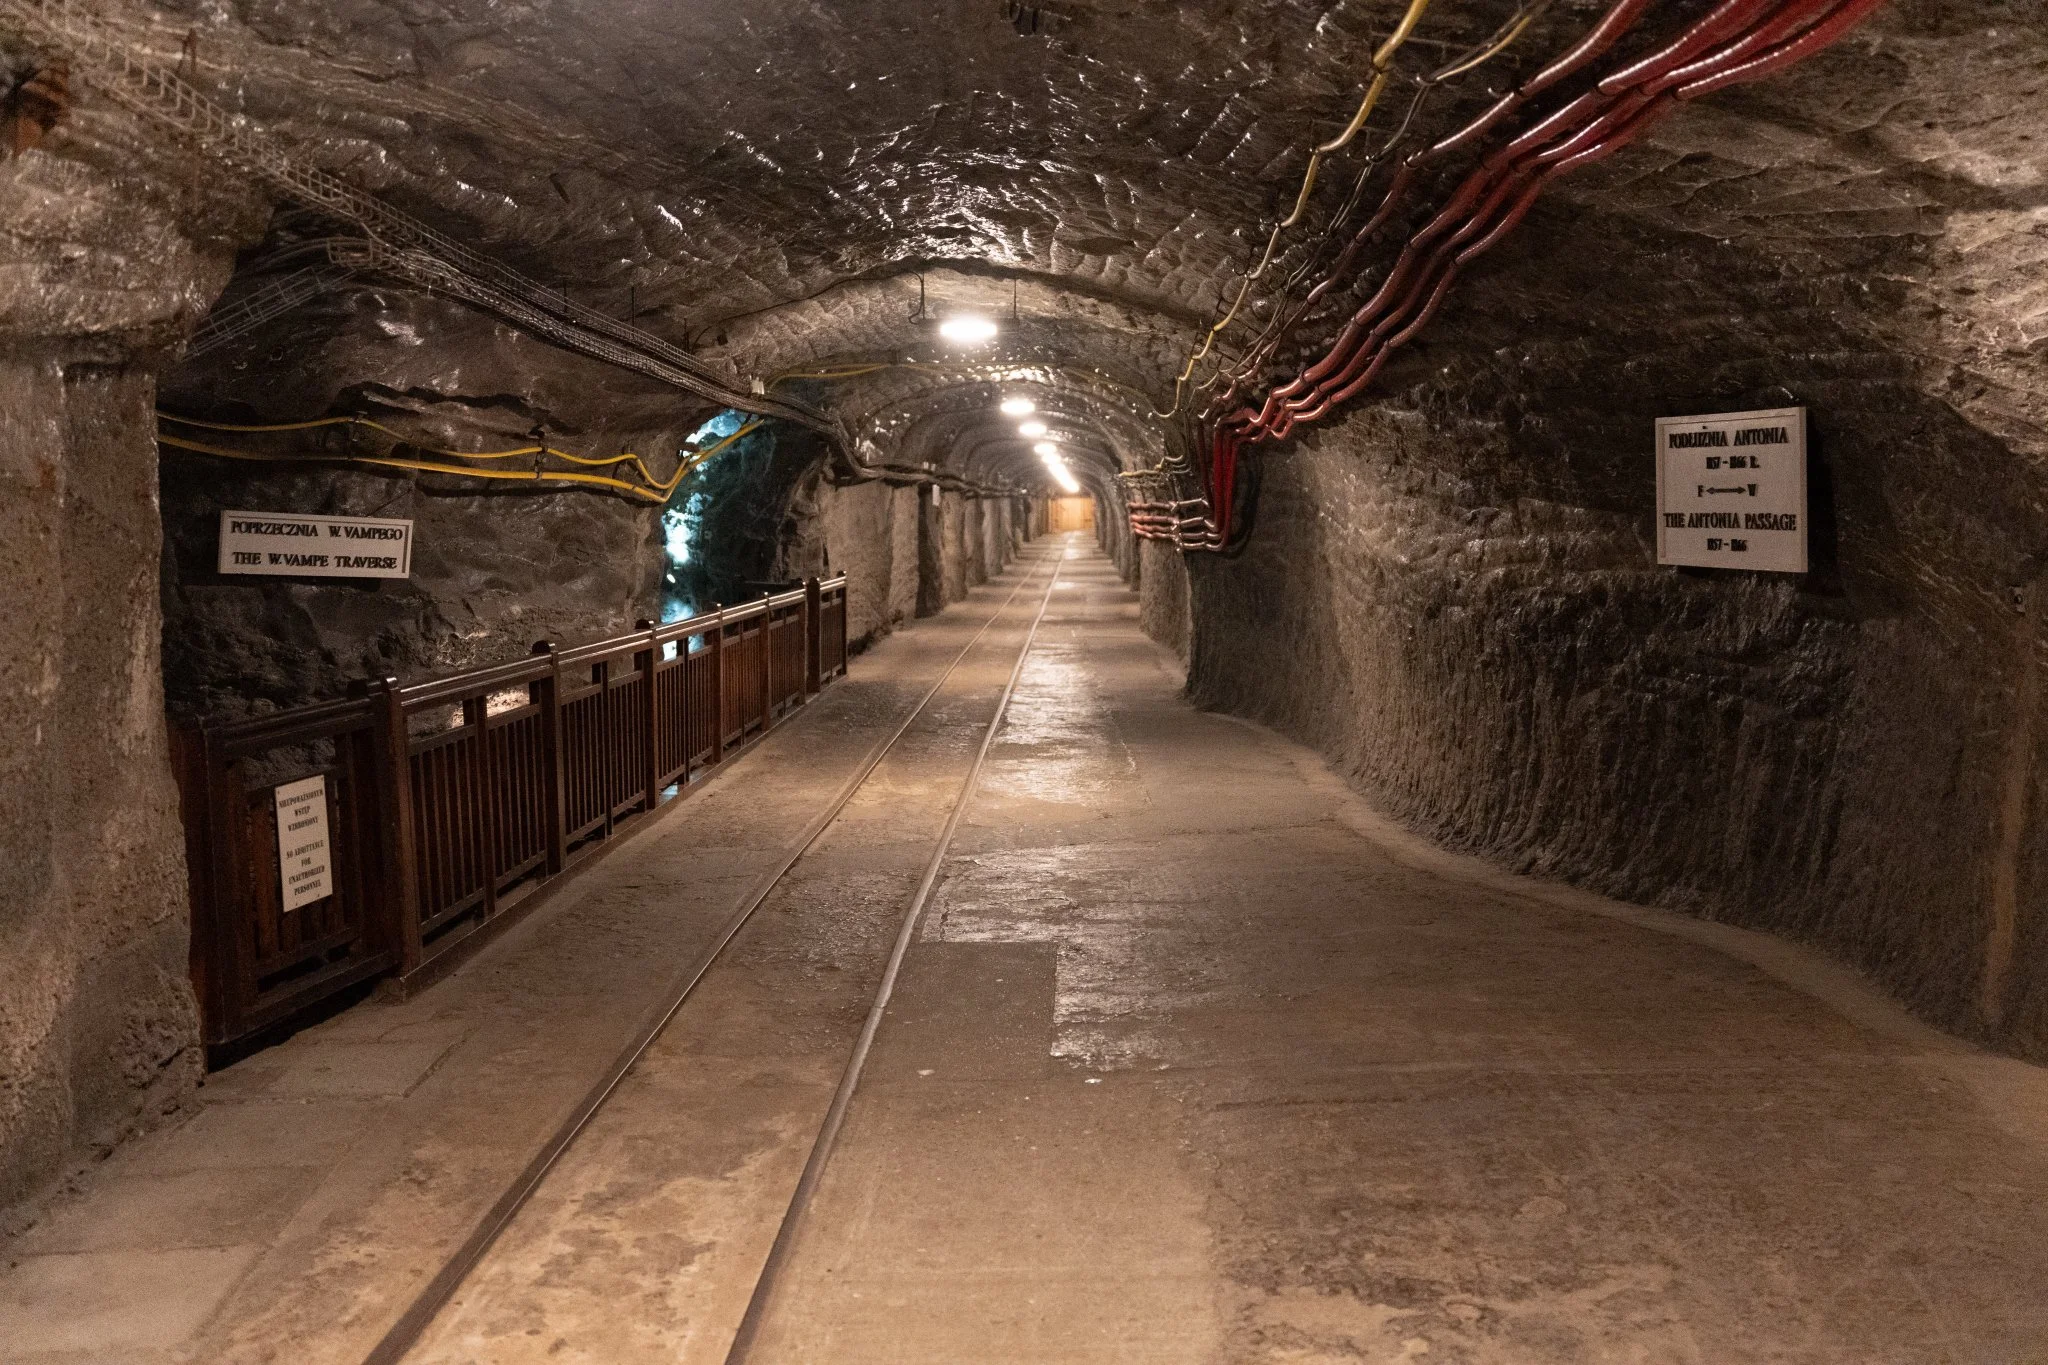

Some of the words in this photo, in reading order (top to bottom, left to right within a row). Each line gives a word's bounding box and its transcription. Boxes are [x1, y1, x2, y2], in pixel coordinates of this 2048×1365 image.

[1669, 425, 1728, 448] PODŁUŻNIA
[1733, 427, 1789, 446] ANTONIA
[1747, 483, 1757, 496] W
[230, 520, 319, 537] POPRZECZNIA
[344, 526, 403, 540] VAMPEGO
[1663, 512, 1686, 529] THE
[1687, 512, 1741, 529] ANTONIA
[1744, 513, 1797, 531] PASSAGE
[232, 551, 262, 565] THE
[333, 555, 398, 569] TRAVERSE
[301, 857, 311, 867] FOR
[294, 879, 322, 896] PERSONNEL
